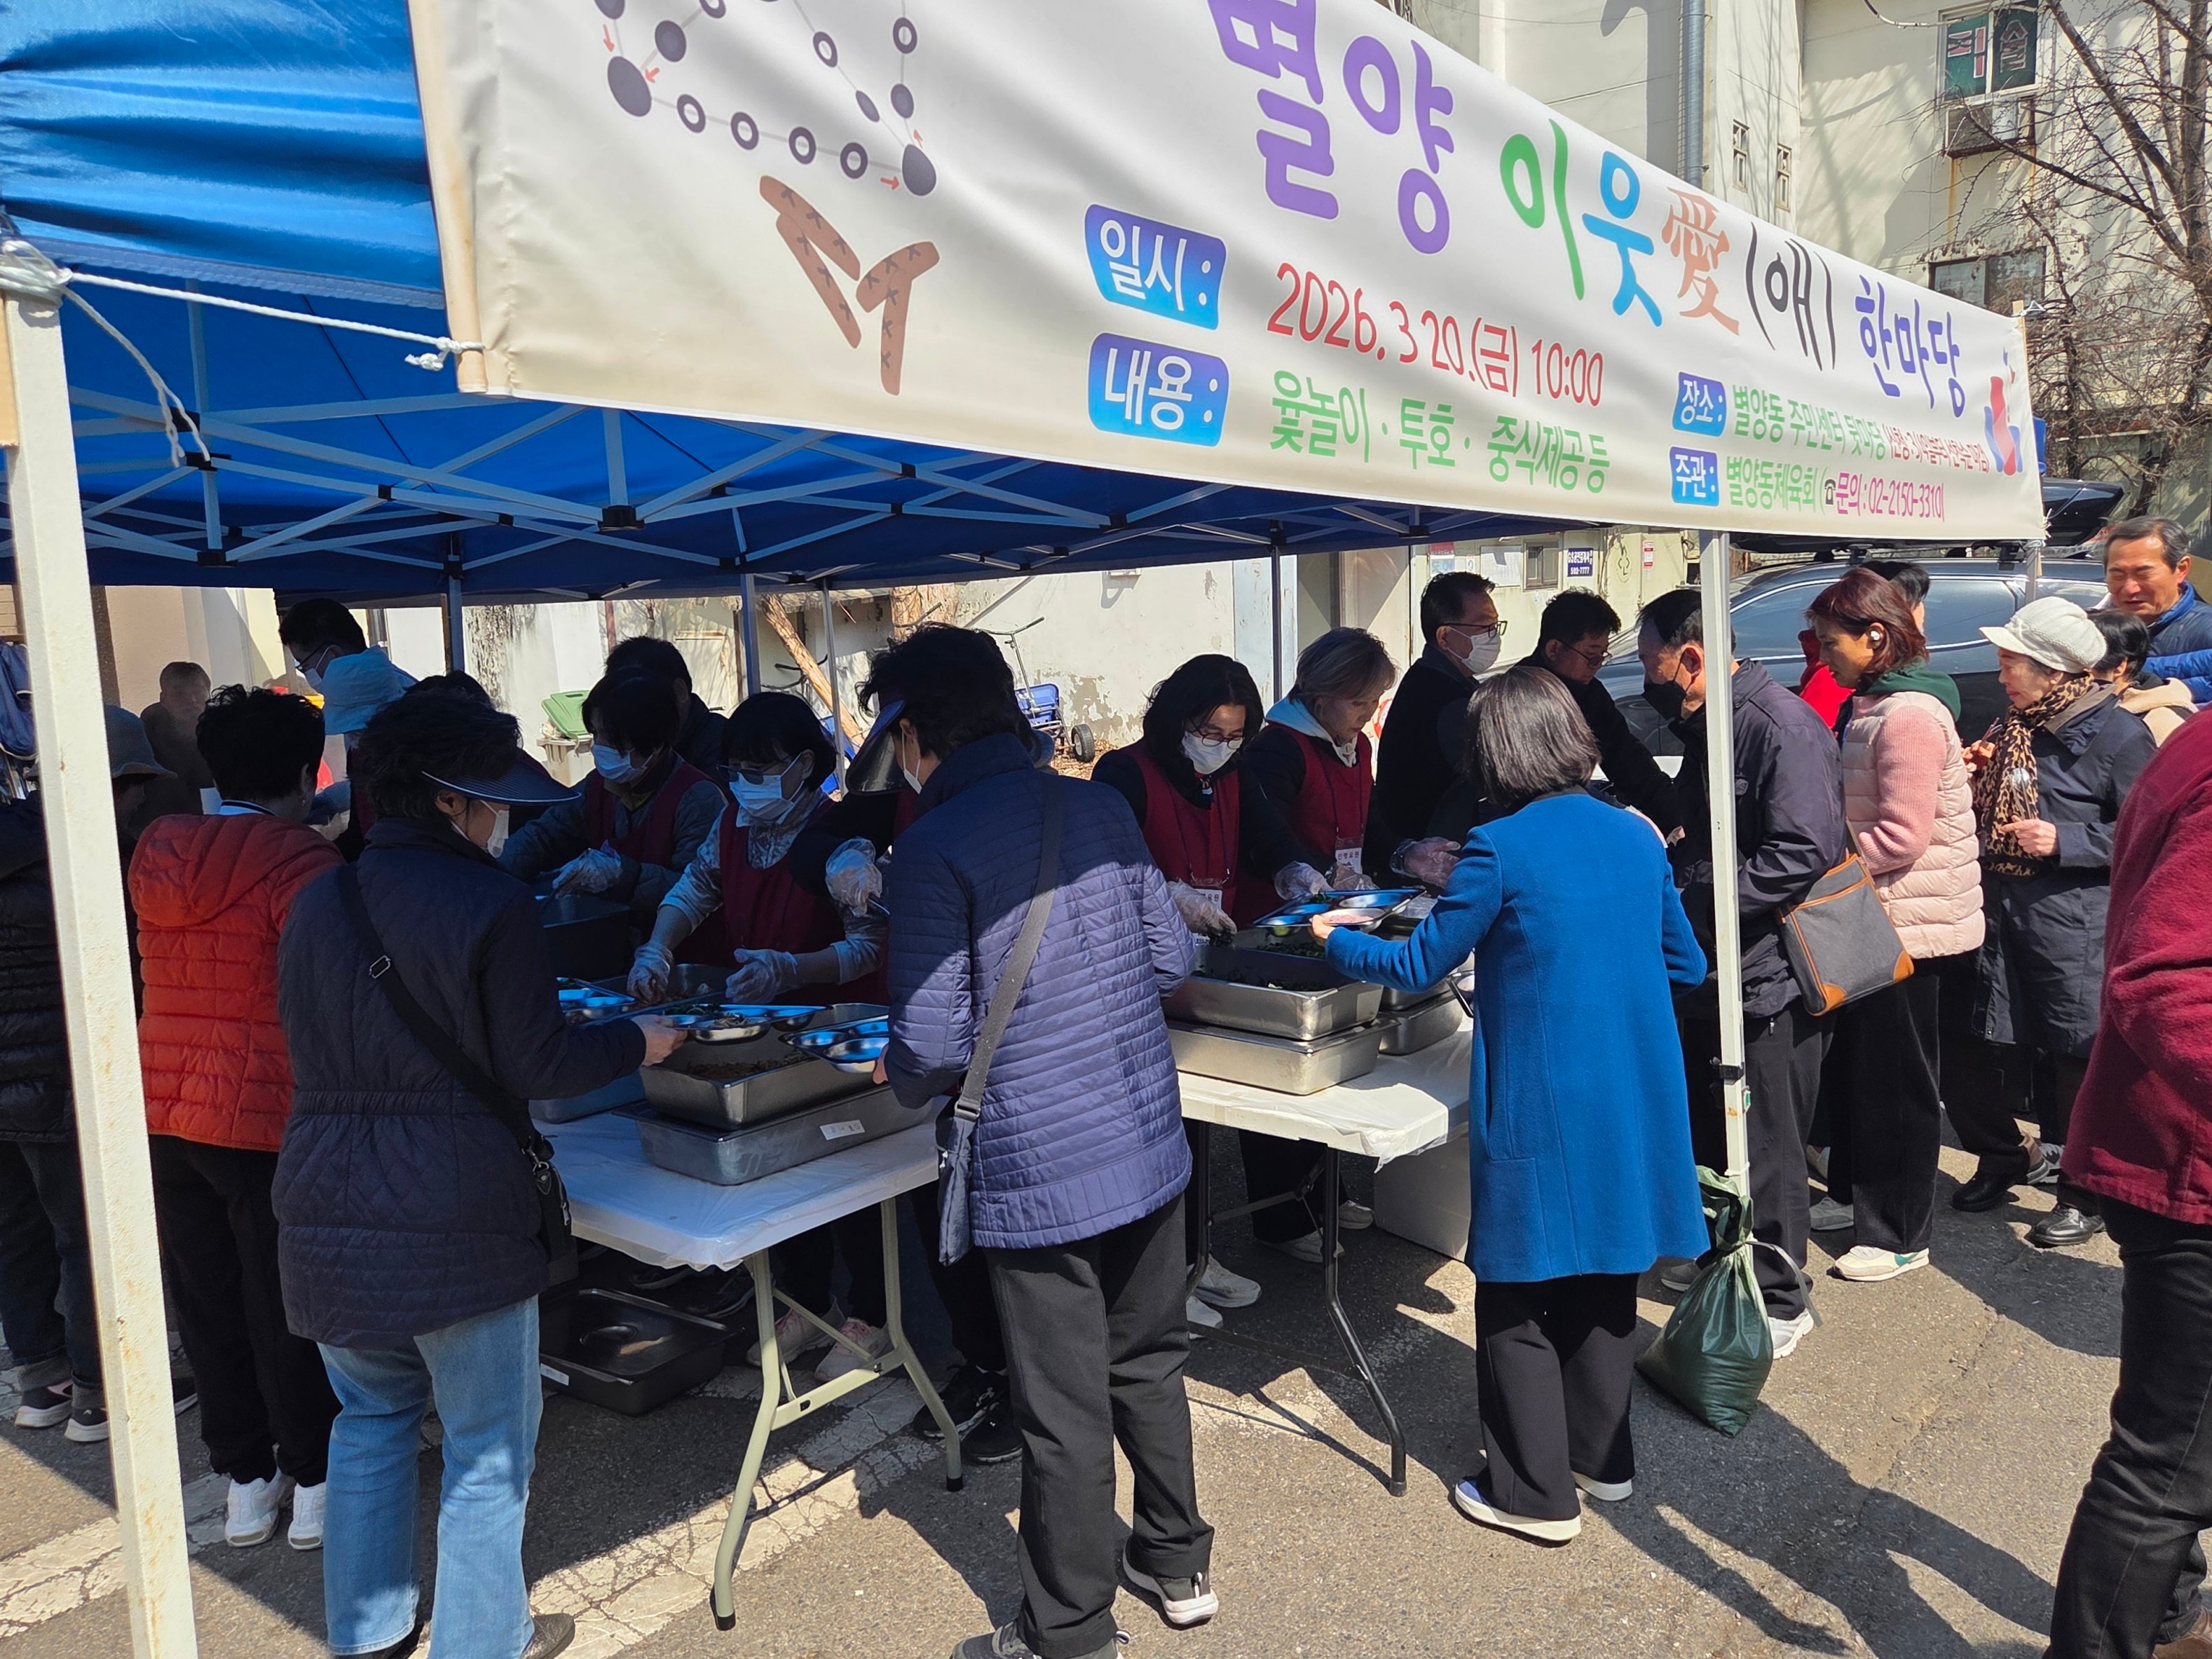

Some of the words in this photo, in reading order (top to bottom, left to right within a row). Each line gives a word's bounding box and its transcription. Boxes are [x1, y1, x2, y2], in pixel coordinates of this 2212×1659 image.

[1531, 338, 1604, 407] 10:00
[1855, 274, 1965, 418] 한마당
[1732, 384, 1786, 443] 별양동
[1787, 399, 1846, 455] 주민센터
[1843, 414, 1886, 460] 뒷마당
